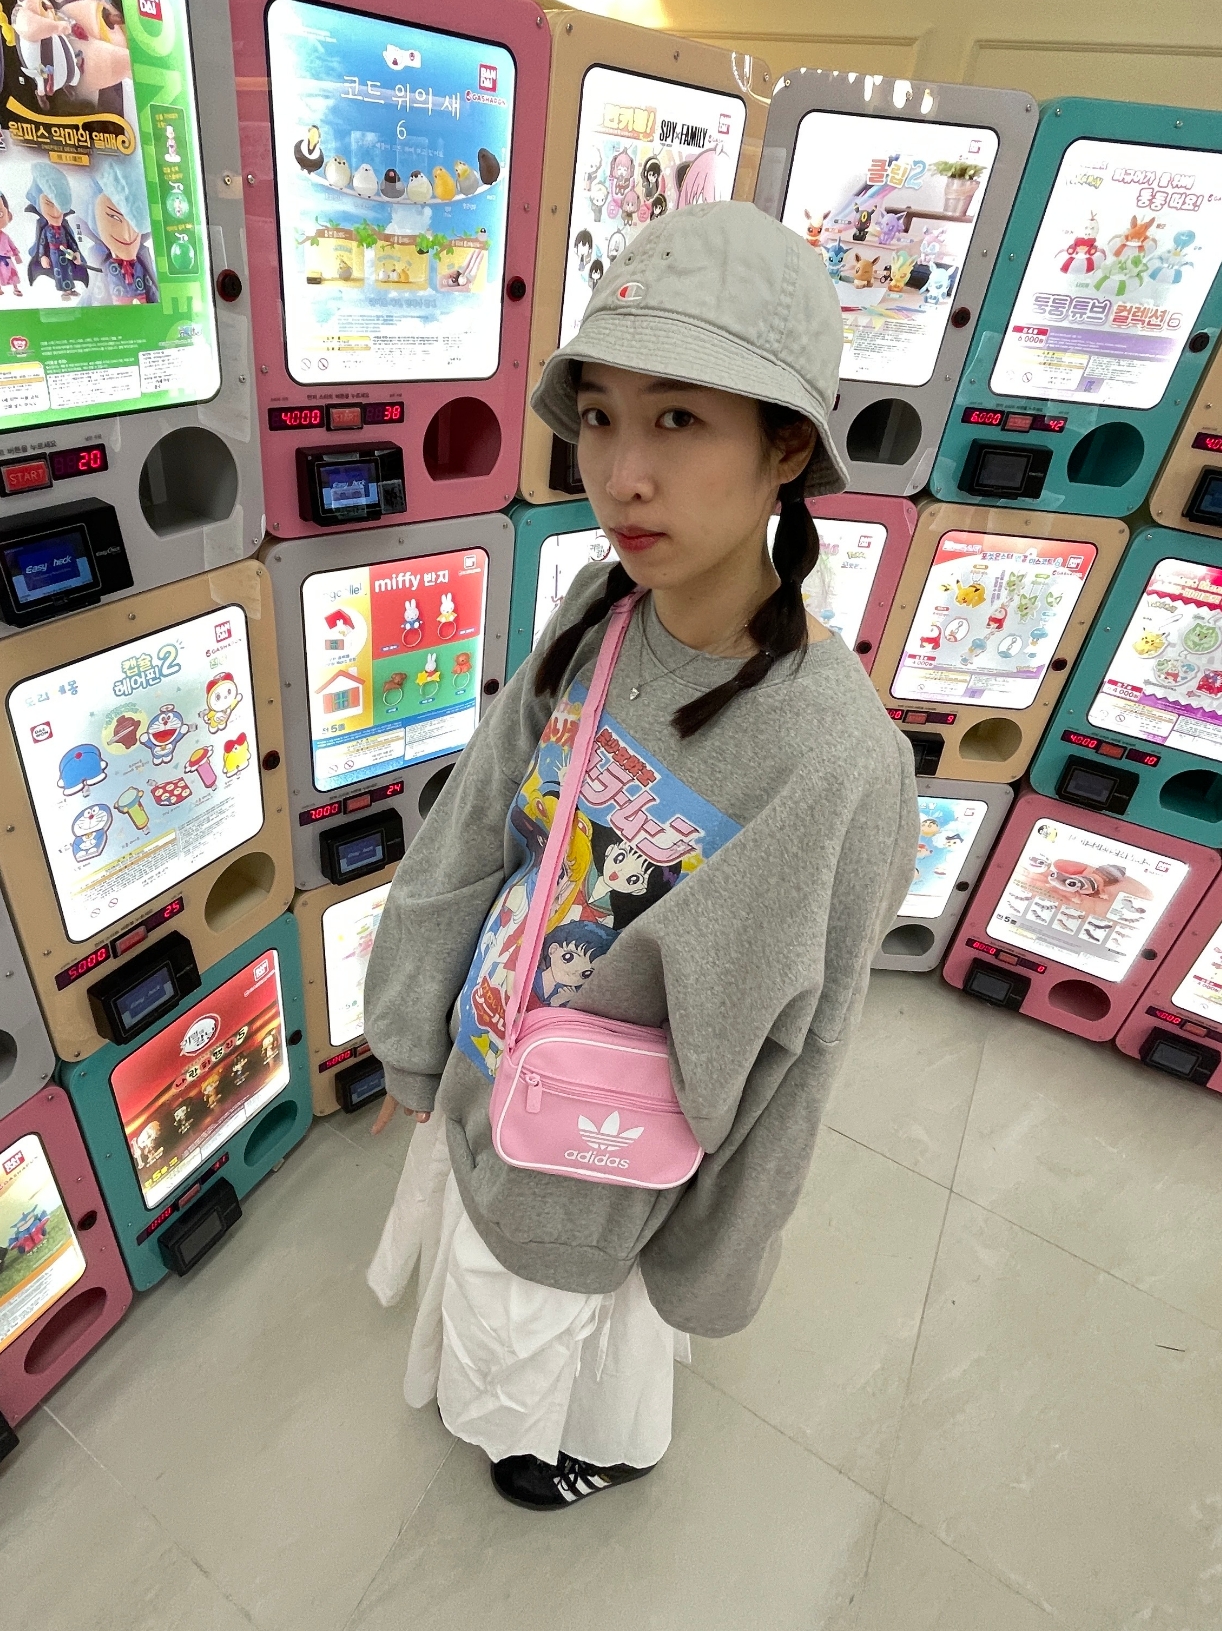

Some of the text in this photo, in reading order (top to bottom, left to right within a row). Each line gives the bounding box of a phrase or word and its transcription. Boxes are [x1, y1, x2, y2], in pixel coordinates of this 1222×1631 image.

[340, 75, 461, 120] 코드 위의 새
[8, 121, 51, 143] 원피스
[51, 126, 91, 148] 악마의
[397, 120, 407, 140] 6
[383, 405, 400, 420] 38
[1049, 420, 1065, 431] 42
[79, 450, 101, 470] 20
[9, 469, 44, 485] START
[25, 562, 48, 574] Easy
[374, 571, 420, 593] miffy
[423, 569, 449, 587] 반지
[121, 652, 153, 677] 캡슐
[157, 643, 182, 678] 2
[112, 664, 162, 697] 헤어핀
[596, 728, 657, 787] 美少女戦士
[1144, 756, 1158, 765] 10
[386, 784, 401, 796] 24
[163, 900, 181, 918] 25
[564, 1147, 630, 1169] adidas
